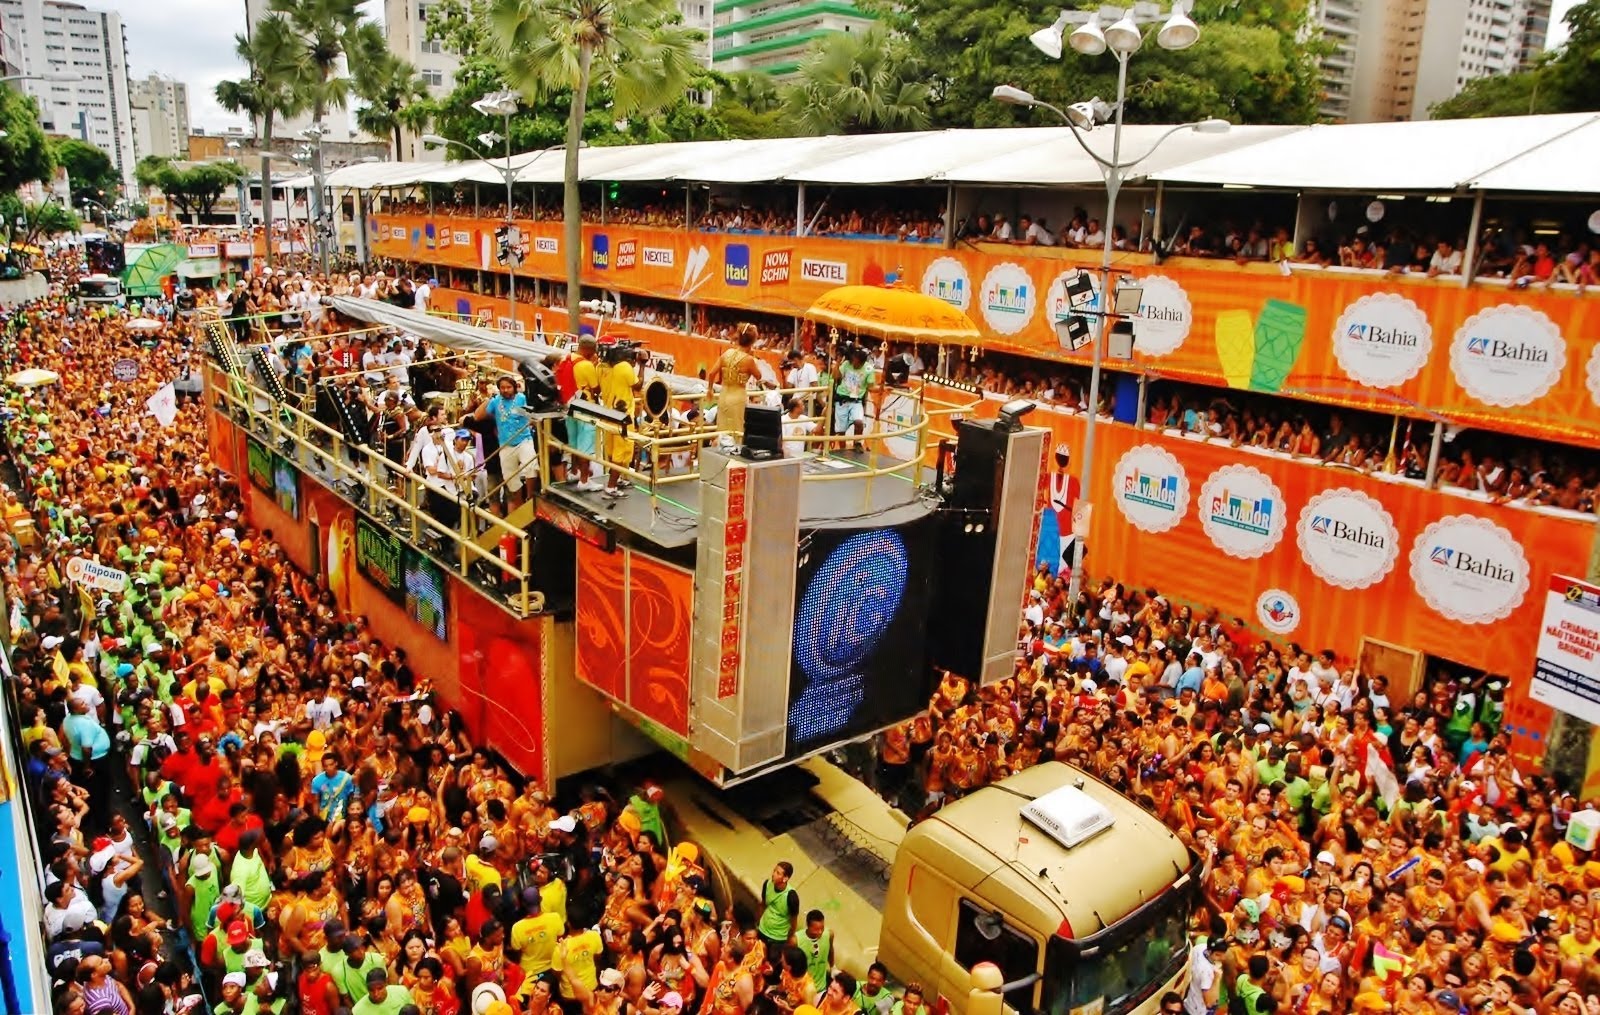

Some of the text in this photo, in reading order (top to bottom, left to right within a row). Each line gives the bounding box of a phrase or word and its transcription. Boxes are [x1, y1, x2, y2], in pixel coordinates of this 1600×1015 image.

[536, 239, 557, 252] NEXTEL
[620, 242, 635, 254] NOVA
[593, 250, 607, 265] Itaú
[618, 254, 635, 266] SCHIN
[644, 250, 673, 265] NEXTEL
[765, 253, 789, 267] NOVA
[725, 263, 748, 281] Itaú
[762, 267, 789, 282] SCHIN
[803, 263, 845, 281] NEXTEL
[1147, 305, 1183, 322] Bahia
[1368, 325, 1417, 347] Bahia
[1491, 340, 1549, 363] Bahia
[1124, 476, 1177, 505] SALVADOR
[1212, 496, 1271, 530] SALVADOR
[1333, 520, 1384, 549] Bahia
[84, 562, 122, 581] Itapoan
[1455, 551, 1515, 583] Bahia
[82, 573, 96, 584] FM
[1557, 640, 1594, 661] BRINCA!
